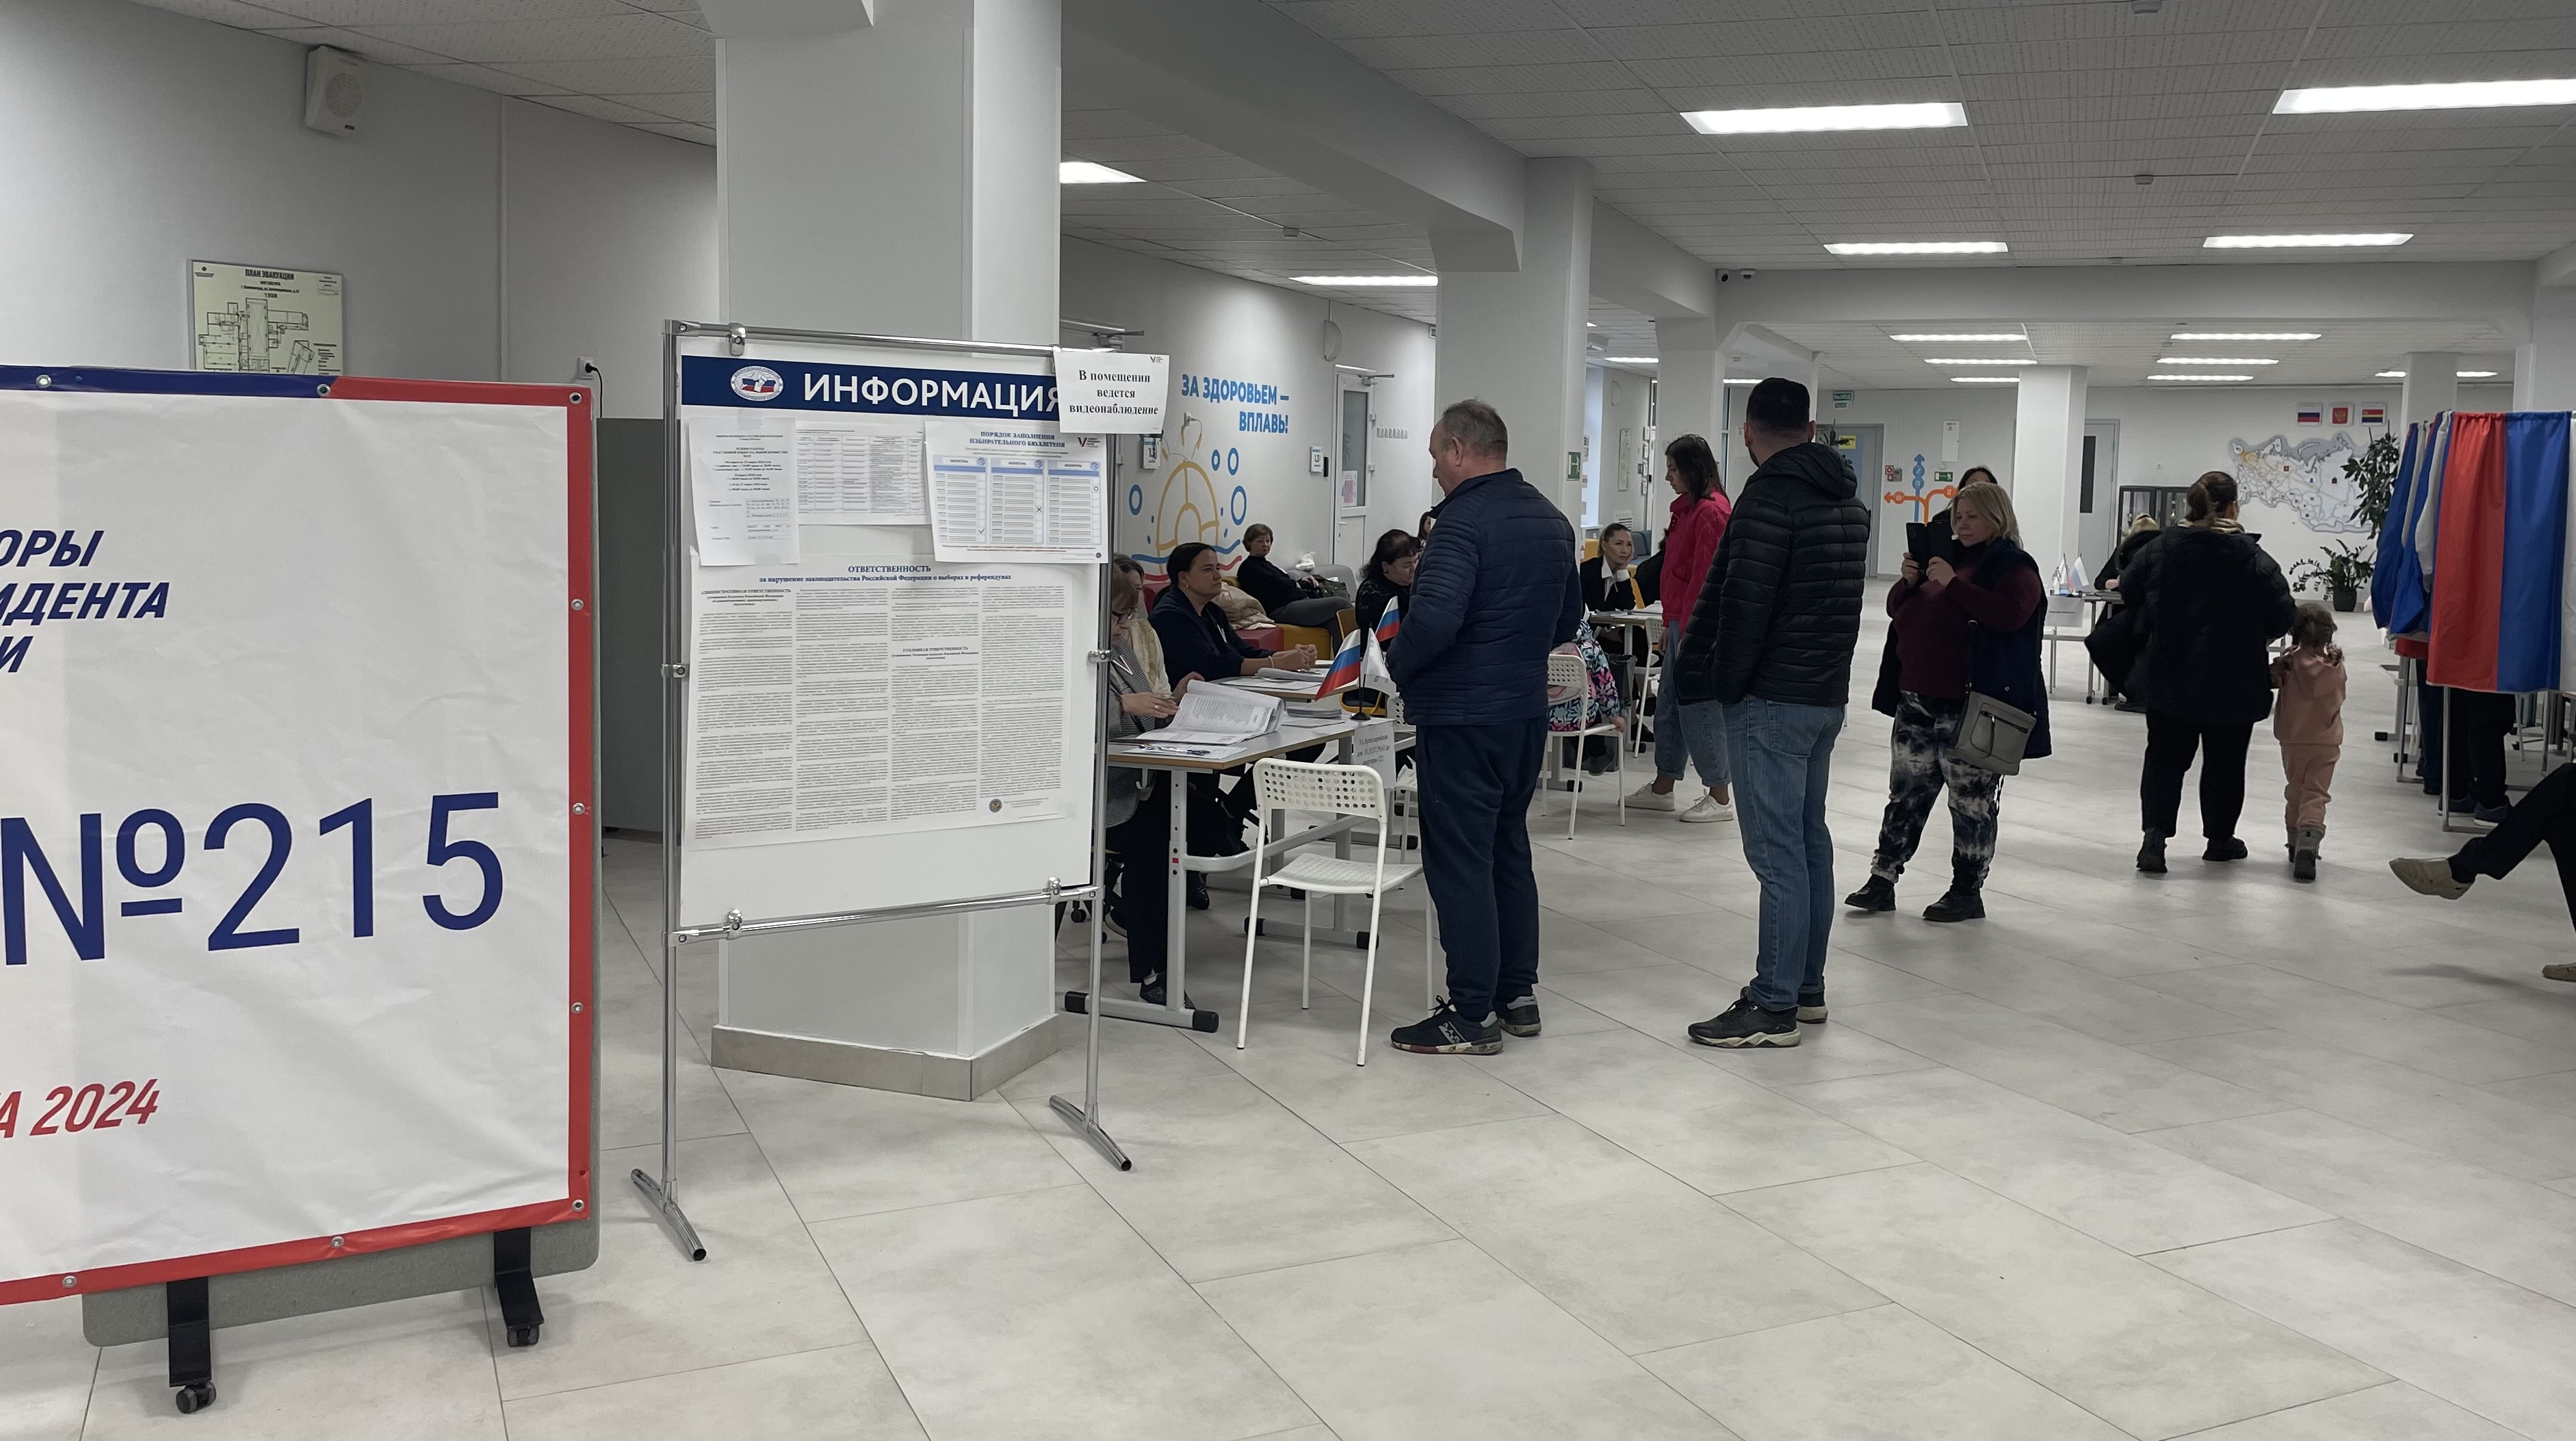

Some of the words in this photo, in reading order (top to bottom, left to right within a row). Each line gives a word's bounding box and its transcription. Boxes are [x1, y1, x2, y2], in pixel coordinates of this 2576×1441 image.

[1079, 370, 1087, 380] В
[1091, 373, 1150, 383] помещении
[804, 372, 1060, 416] ИНФОРМАЦИЯ
[1097, 389, 1136, 398] ведется
[1181, 374, 1199, 398] ЗА
[1203, 377, 1277, 405] ЗДОРОВЬЕМ
[1069, 404, 1159, 415] видеонаблюдение
[1239, 411, 1289, 434] ВПЛАВЬ!
[0, 1091, 22, 1139] А
[29, 1078, 160, 1137] 2024
